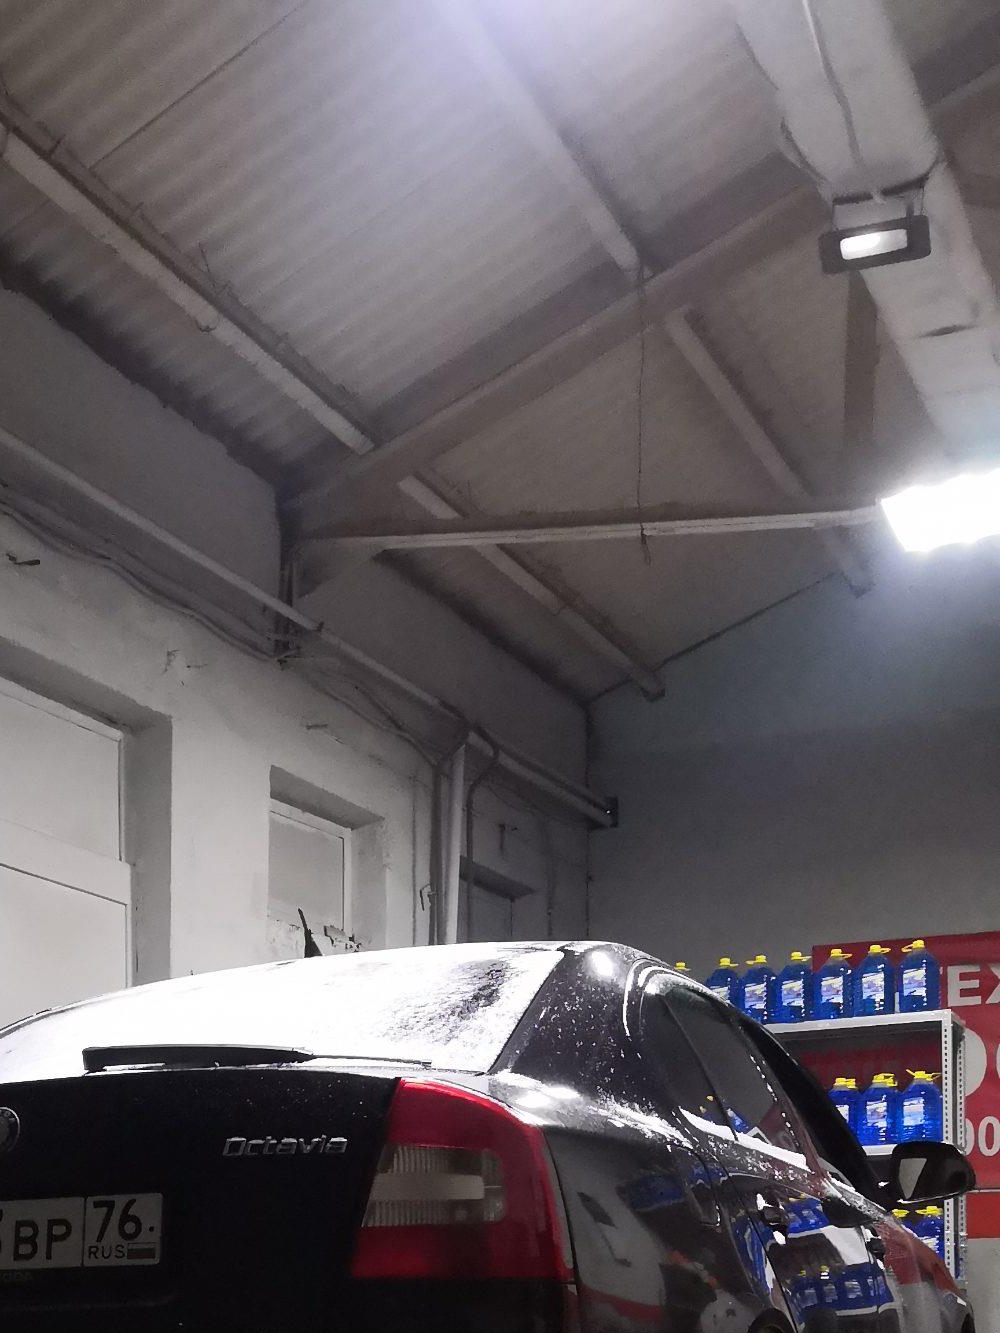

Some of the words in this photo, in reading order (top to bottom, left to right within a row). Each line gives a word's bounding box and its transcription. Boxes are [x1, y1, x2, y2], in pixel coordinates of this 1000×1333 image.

[222, 1134, 348, 1157] Octavia
[92, 1198, 143, 1243] 76
[88, 1245, 127, 1260] RUS
